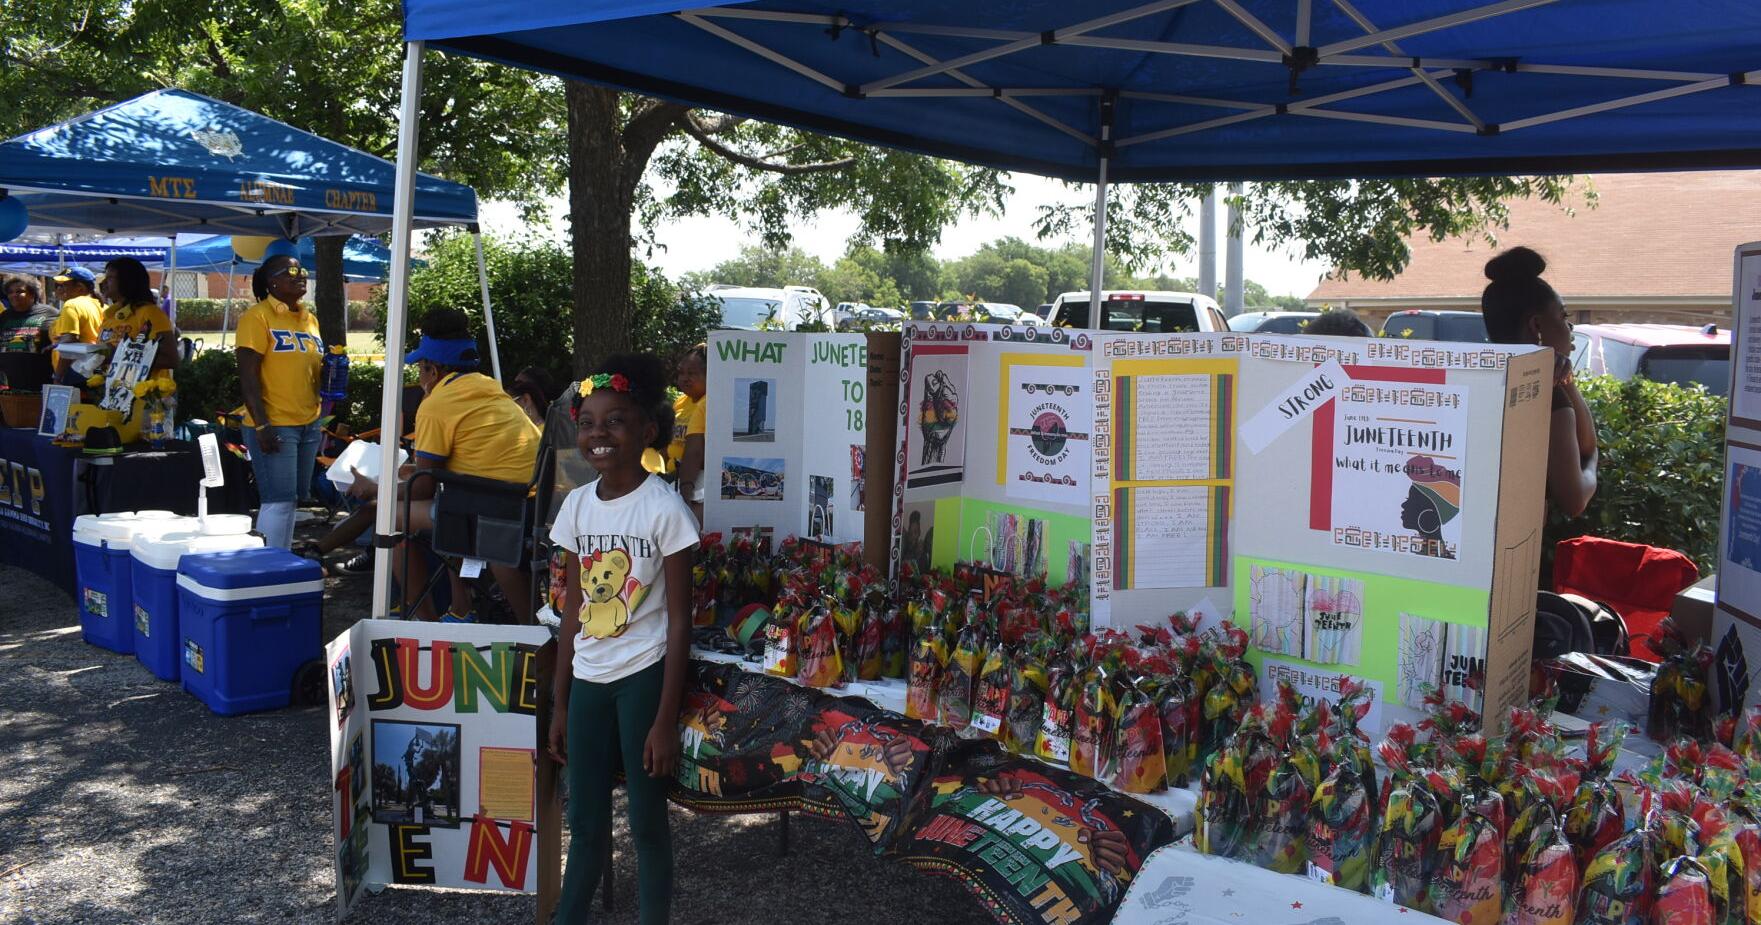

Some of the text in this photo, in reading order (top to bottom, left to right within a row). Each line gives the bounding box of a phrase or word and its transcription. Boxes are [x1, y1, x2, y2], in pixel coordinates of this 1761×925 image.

[325, 189, 377, 211] CHAPTER
[716, 339, 788, 363] WHAT
[841, 379, 864, 403] TO
[1278, 373, 1334, 420] STRONG
[846, 408, 867, 432] 18
[1029, 402, 1071, 421] JUNETEENTH
[1344, 425, 1453, 452] JUNETEENTH
[1027, 444, 1071, 466] FREEDOM DAY
[1370, 459, 1380, 473] it
[1384, 461, 1424, 476] means
[367, 637, 536, 715] JUNE
[966, 798, 1084, 869] HAPPY
